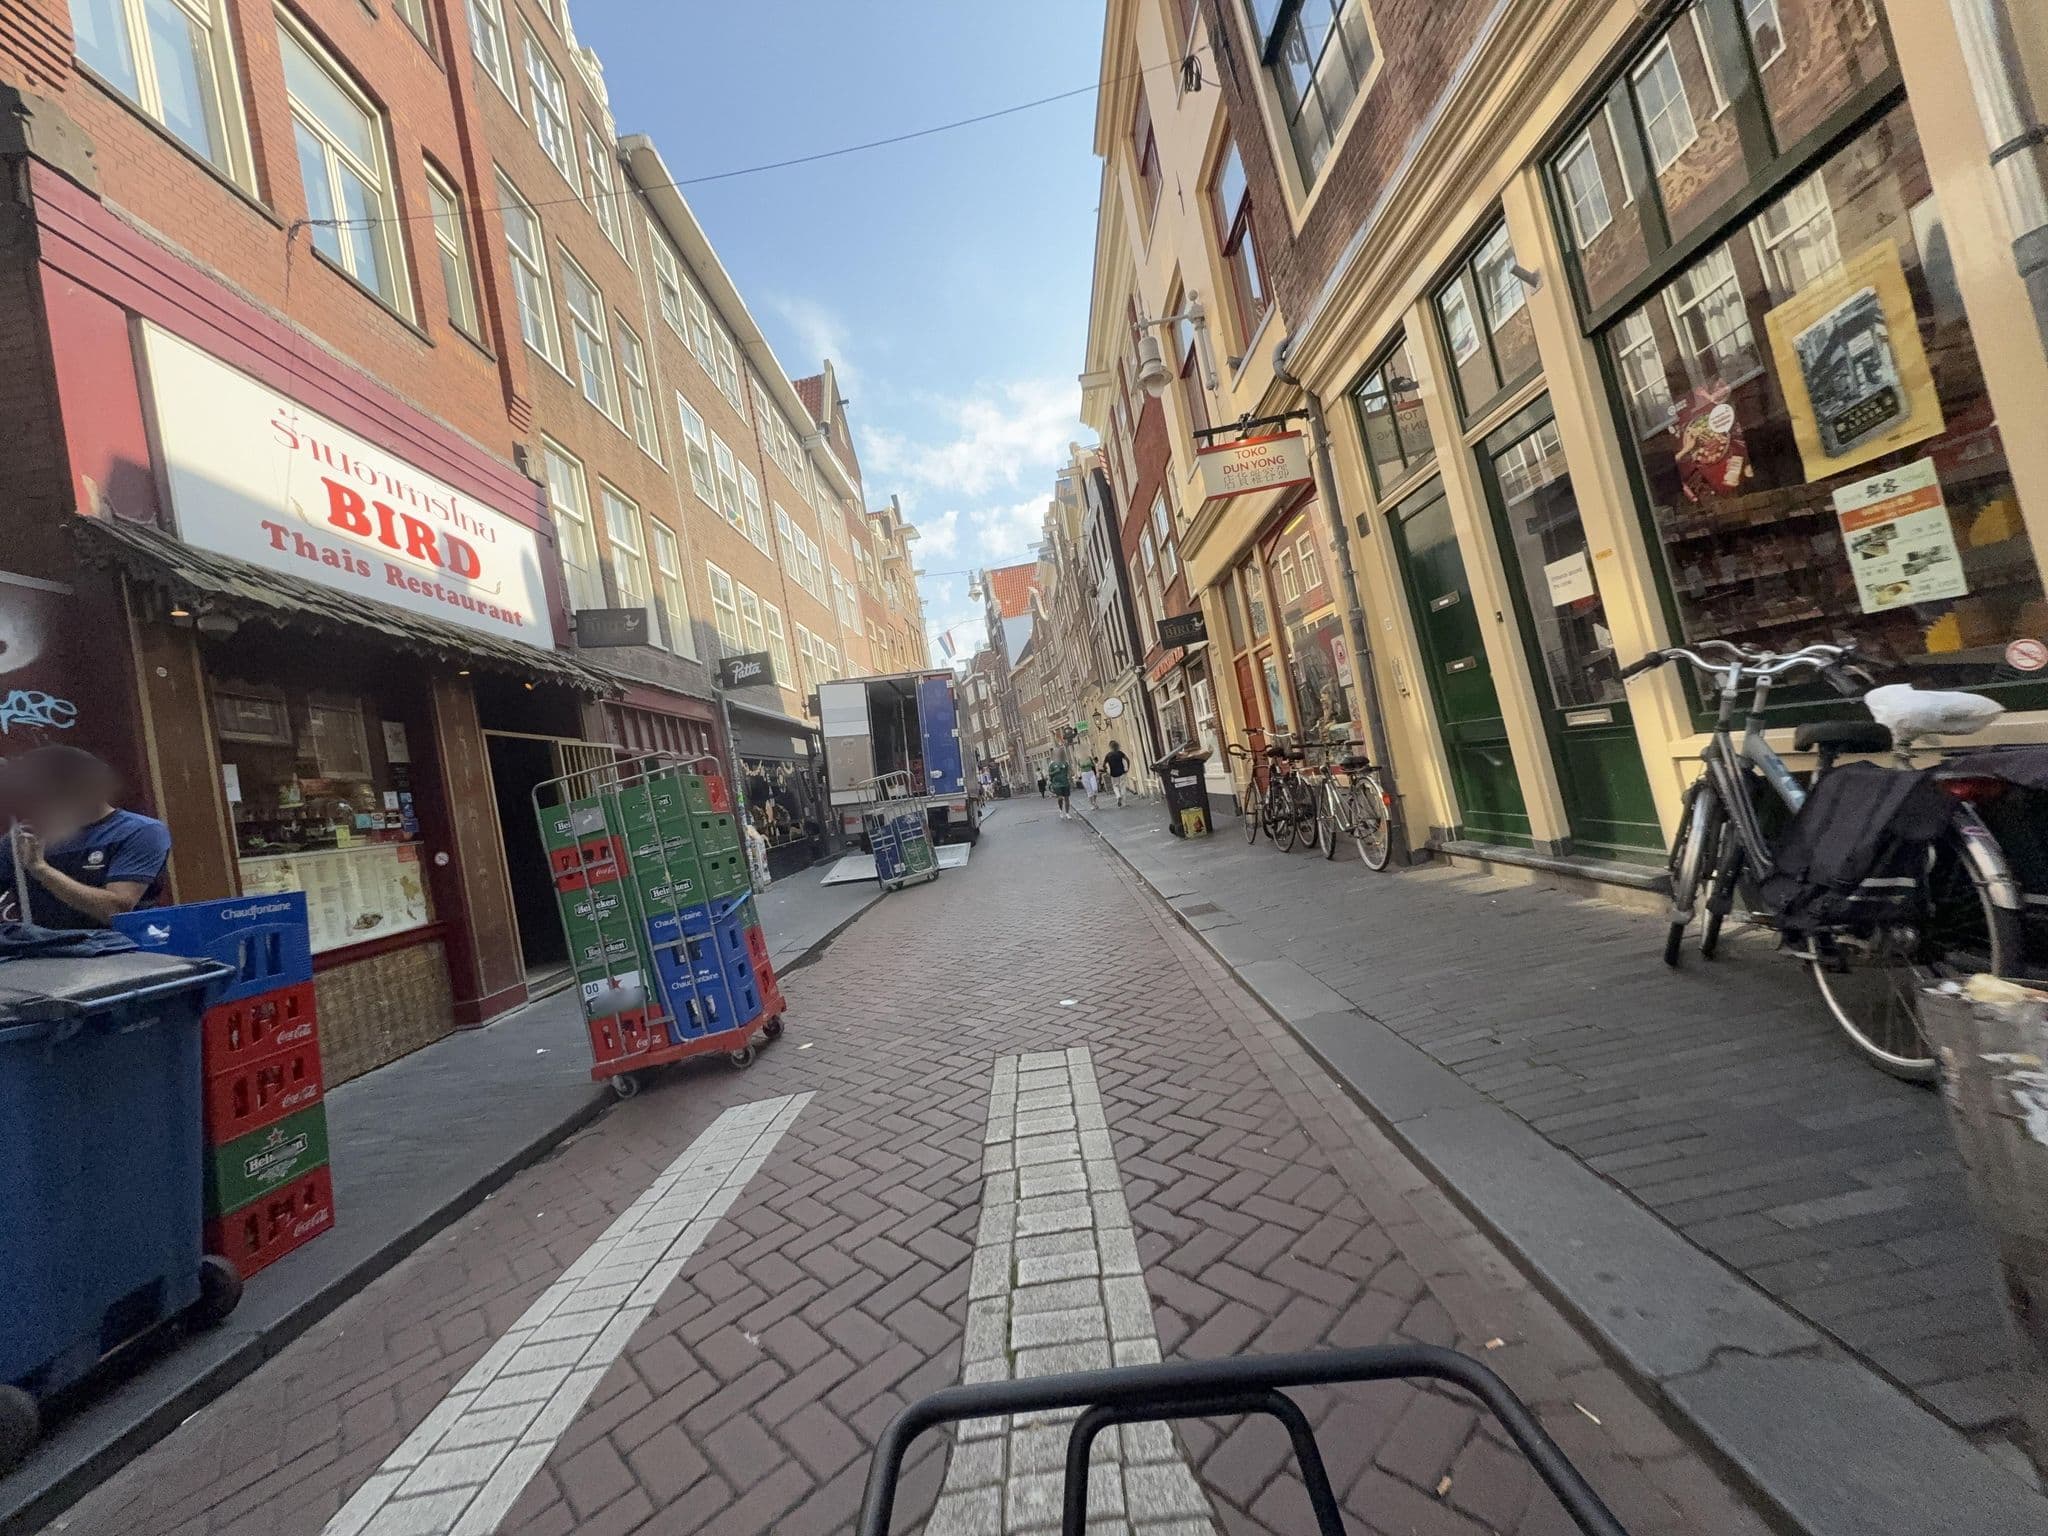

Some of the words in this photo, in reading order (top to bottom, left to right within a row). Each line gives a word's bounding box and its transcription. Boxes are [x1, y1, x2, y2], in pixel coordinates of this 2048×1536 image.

[1235, 446, 1267, 459] TOKO
[1223, 461, 1249, 474] DUN
[1251, 455, 1285, 469] YONG
[320, 476, 482, 580] BIRD
[261, 519, 371, 578] Thais
[384, 562, 524, 627] Restaurant
[728, 660, 761, 684] Patta
[652, 881, 691, 899] Heinken
[221, 901, 292, 920] Chaudfontaine
[577, 896, 617, 914] Heieken
[654, 910, 702, 928] Chaudfntaine
[587, 941, 627, 957] Heieken
[671, 972, 720, 990] Chaudontaine
[248, 1139, 304, 1173] Heien
